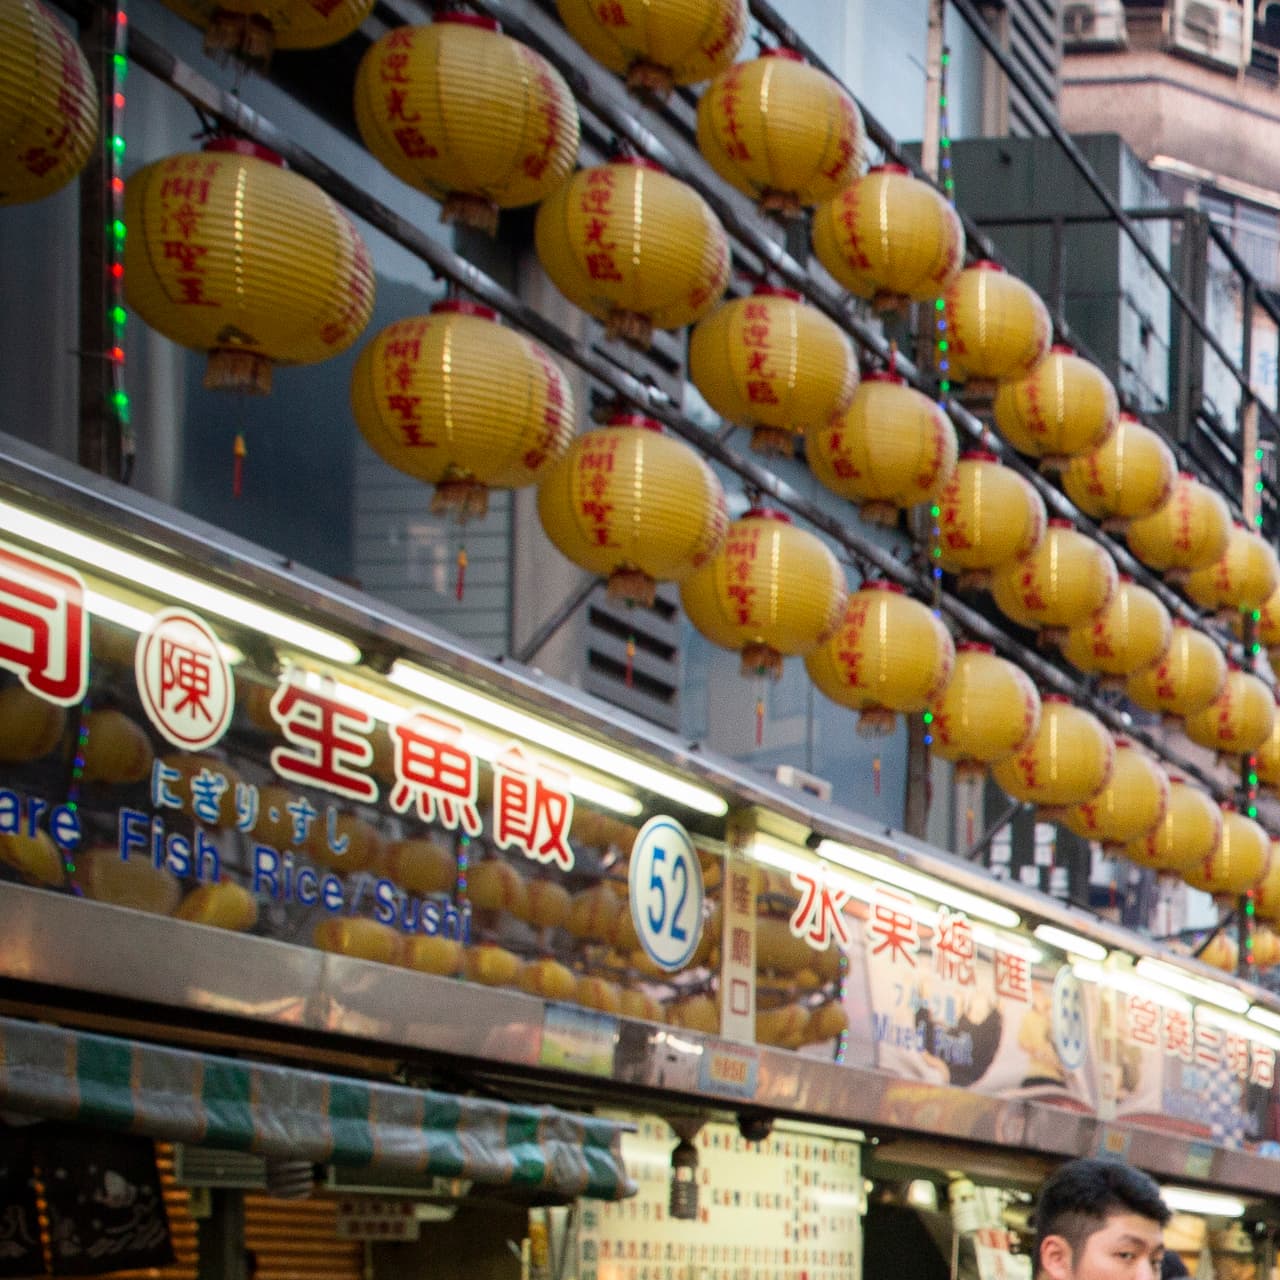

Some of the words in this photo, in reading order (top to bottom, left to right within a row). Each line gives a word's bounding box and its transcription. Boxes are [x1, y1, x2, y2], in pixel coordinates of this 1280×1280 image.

[158, 636, 213, 723] 陳
[276, 664, 574, 870] 生魚飯
[117, 808, 222, 883] Fish
[648, 848, 690, 930] 52
